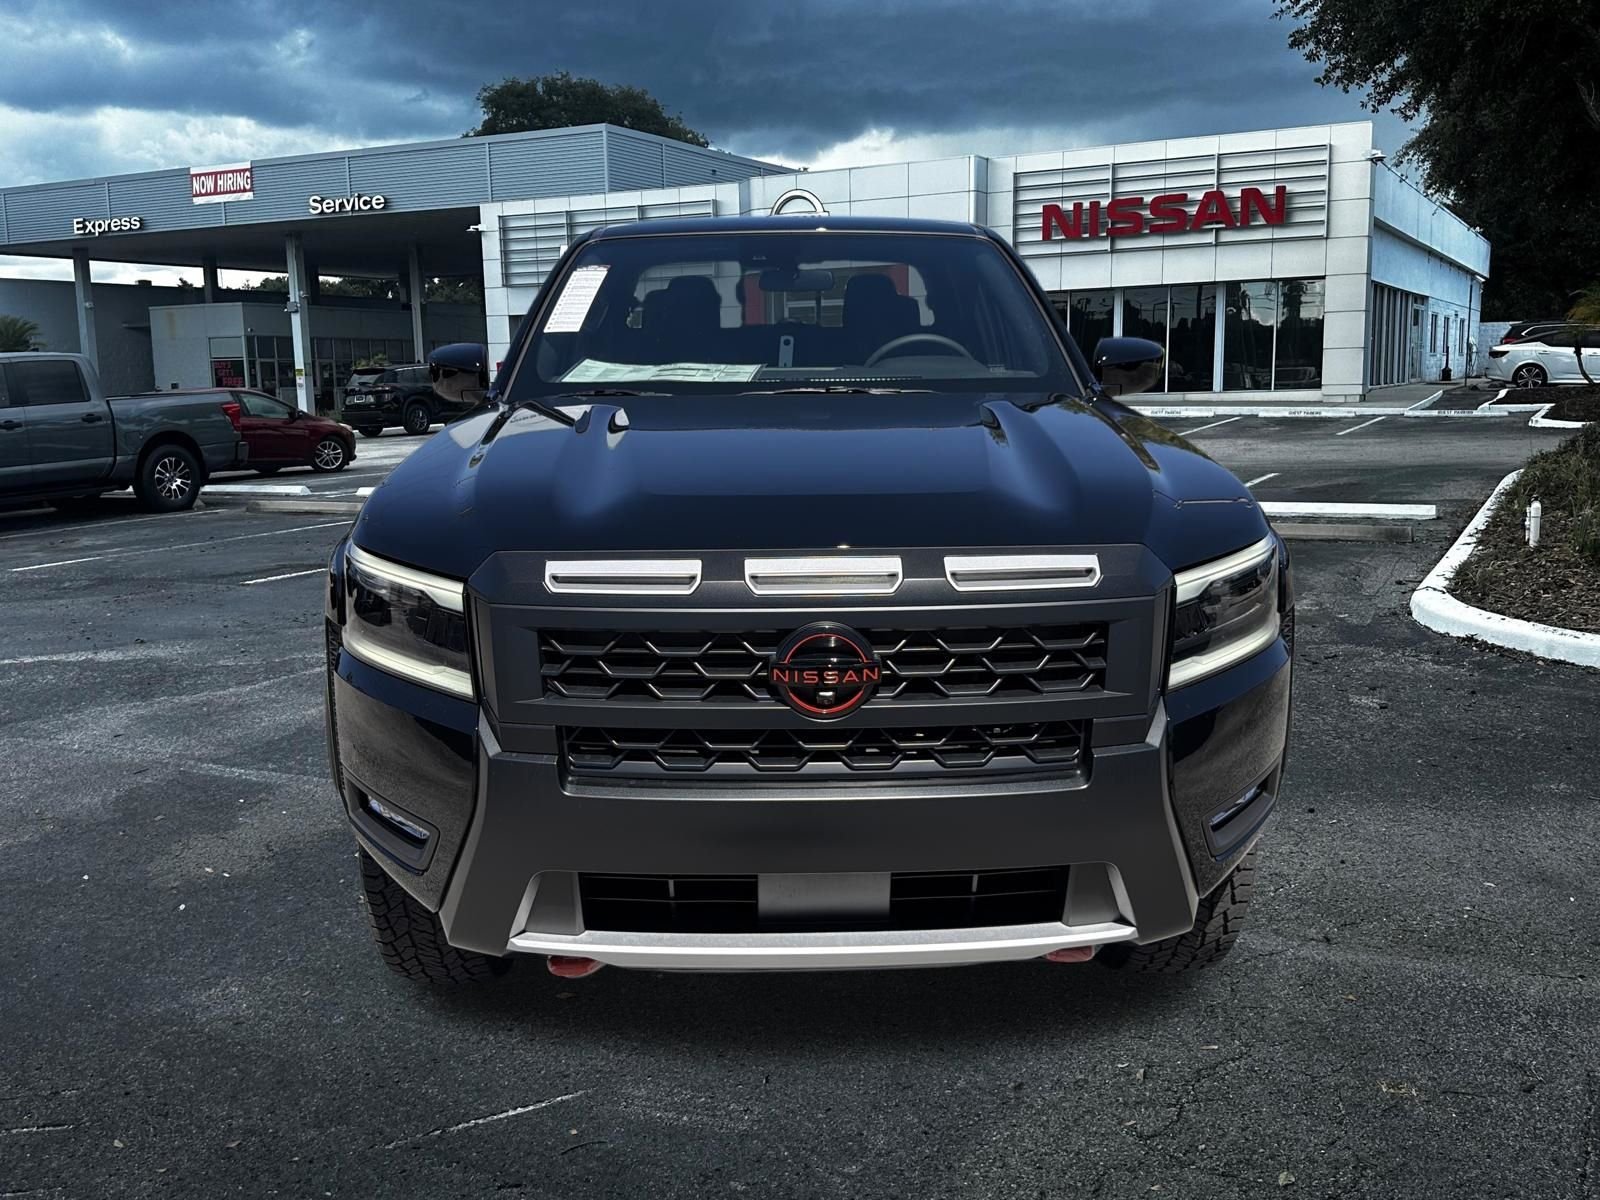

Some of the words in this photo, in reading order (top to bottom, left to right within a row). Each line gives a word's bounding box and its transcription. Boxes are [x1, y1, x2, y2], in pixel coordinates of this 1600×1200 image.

[193, 175, 215, 195] NOW
[217, 171, 251, 192] HIRING
[309, 193, 385, 214] Service
[1042, 185, 1287, 241] NISSAN
[73, 216, 141, 237] Express
[773, 667, 879, 684] NISSAN
